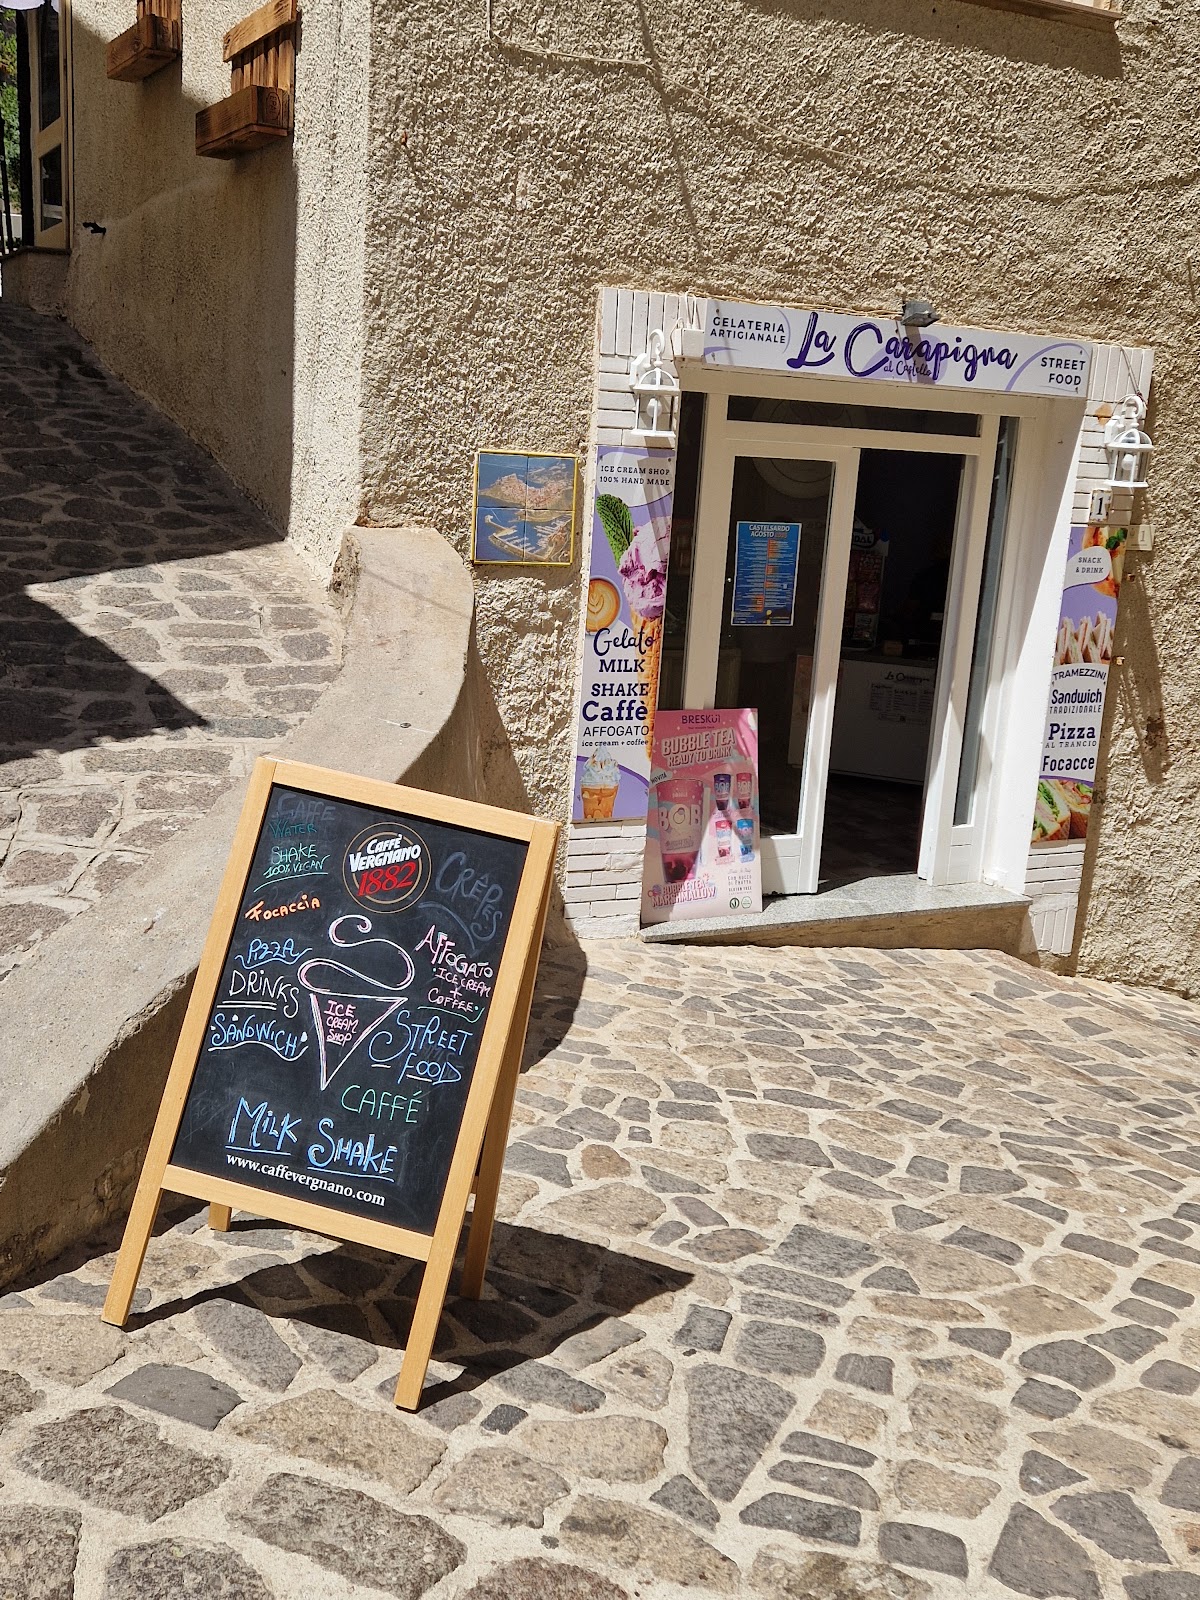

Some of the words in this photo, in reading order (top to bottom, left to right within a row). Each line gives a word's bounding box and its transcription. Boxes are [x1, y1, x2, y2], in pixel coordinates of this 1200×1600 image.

[712, 316, 785, 333] GELATERIA
[710, 328, 786, 344] ARTIGIANALE
[787, 311, 837, 369] La
[844, 321, 1018, 382] Carapigna
[1040, 357, 1086, 371] STREET
[1048, 373, 1082, 386] FOOD
[600, 465, 615, 473] ICE
[617, 466, 646, 474] CREAM
[648, 468, 670, 476] SHOP
[621, 477, 645, 485] HAND
[647, 478, 670, 486] MADE
[1078, 556, 1102, 564] SNACK
[1081, 566, 1104, 574] DRINK
[593, 626, 655, 657] Gelato
[598, 658, 646, 673] MILK
[1052, 668, 1107, 682] TRAMEZZINI
[591, 682, 650, 698] SHAKE
[1051, 689, 1103, 705] Sandwich
[582, 699, 649, 722] Caffè
[1050, 704, 1102, 714] TRADIZIONALE
[583, 725, 650, 738] AFFOGATO
[1048, 722, 1096, 741] Pizza
[626, 738, 649, 746] coffee
[662, 731, 711, 757] BUBBLE
[713, 728, 736, 748] TEA
[1059, 740, 1097, 748] TRANCIO
[668, 753, 695, 767] READY
[696, 751, 707, 762] TO
[708, 746, 732, 760] DRINK
[1042, 756, 1095, 772] Focacce
[269, 820, 317, 838] WATER
[271, 843, 318, 865] SHAKE
[349, 844, 422, 873] VERGNANO
[357, 861, 417, 897] 1882
[415, 924, 494, 979] AFFOGATO
[435, 967, 459, 985] ICE
[460, 978, 491, 998] CREAM
[323, 1000, 357, 1018] ICE
[428, 988, 473, 1012] COFFEE
[326, 1016, 359, 1034] CREAM
[326, 1029, 352, 1047] SHOP
[368, 1009, 473, 1063] STREET
[397, 1053, 462, 1085] FOOD
[307, 1117, 398, 1174] SHAKE
[226, 1153, 386, 1207] www.caffevergnano.com
